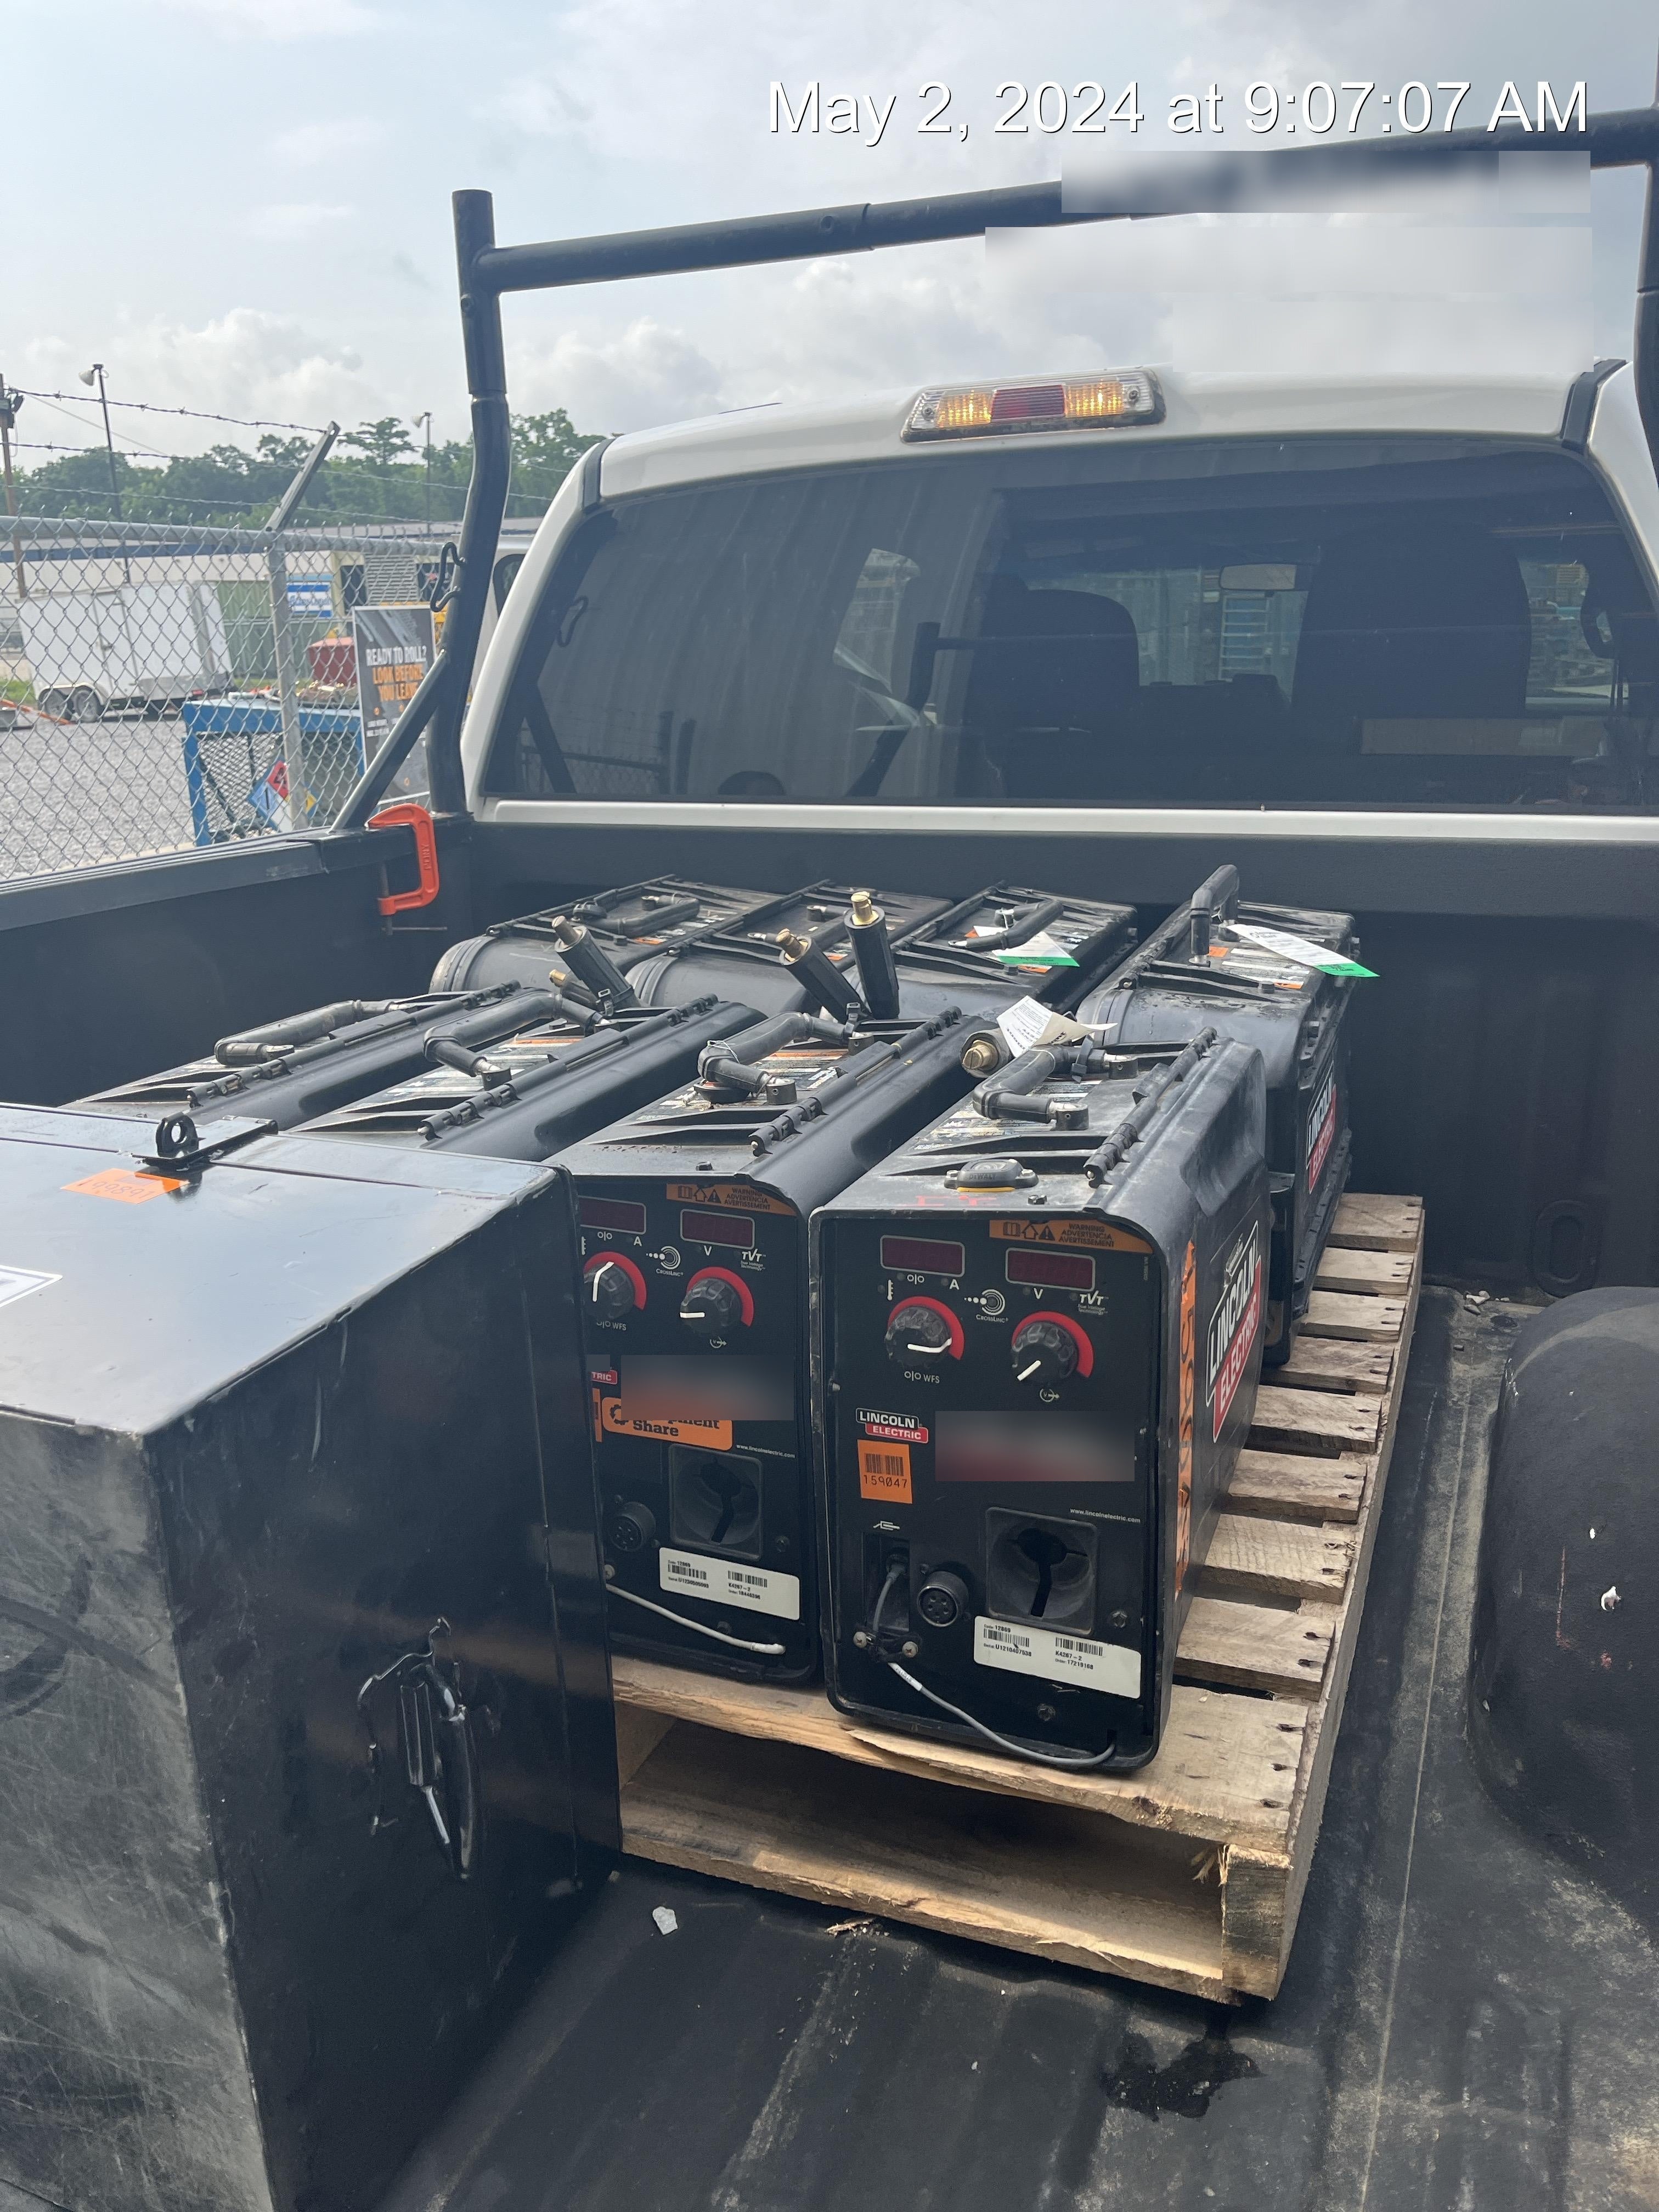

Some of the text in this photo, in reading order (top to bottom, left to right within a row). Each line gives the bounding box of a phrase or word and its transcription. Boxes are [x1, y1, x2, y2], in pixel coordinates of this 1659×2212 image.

[366, 647, 393, 666] READY
[393, 647, 404, 664] TO
[1307, 1073, 1333, 1158] LINCOLN
[1069, 1223, 1105, 1233] WARNING
[633, 1235, 642, 1247] A
[1058, 1236, 1115, 1247] AVERTISSEMENT
[703, 1245, 713, 1256] V
[949, 1279, 960, 1290] A
[1034, 1288, 1043, 1300] V
[1210, 1238, 1257, 1386] LINCOLN
[1220, 1293, 1257, 1408] ELECTRIC
[923, 1374, 940, 1384] WFS
[860, 1410, 915, 1429] LINCOLN
[872, 1425, 922, 1440] ELECTRIC
[864, 1475, 907, 1488] 159047
[1070, 1508, 1141, 1523] www.lincolnelectric.com
